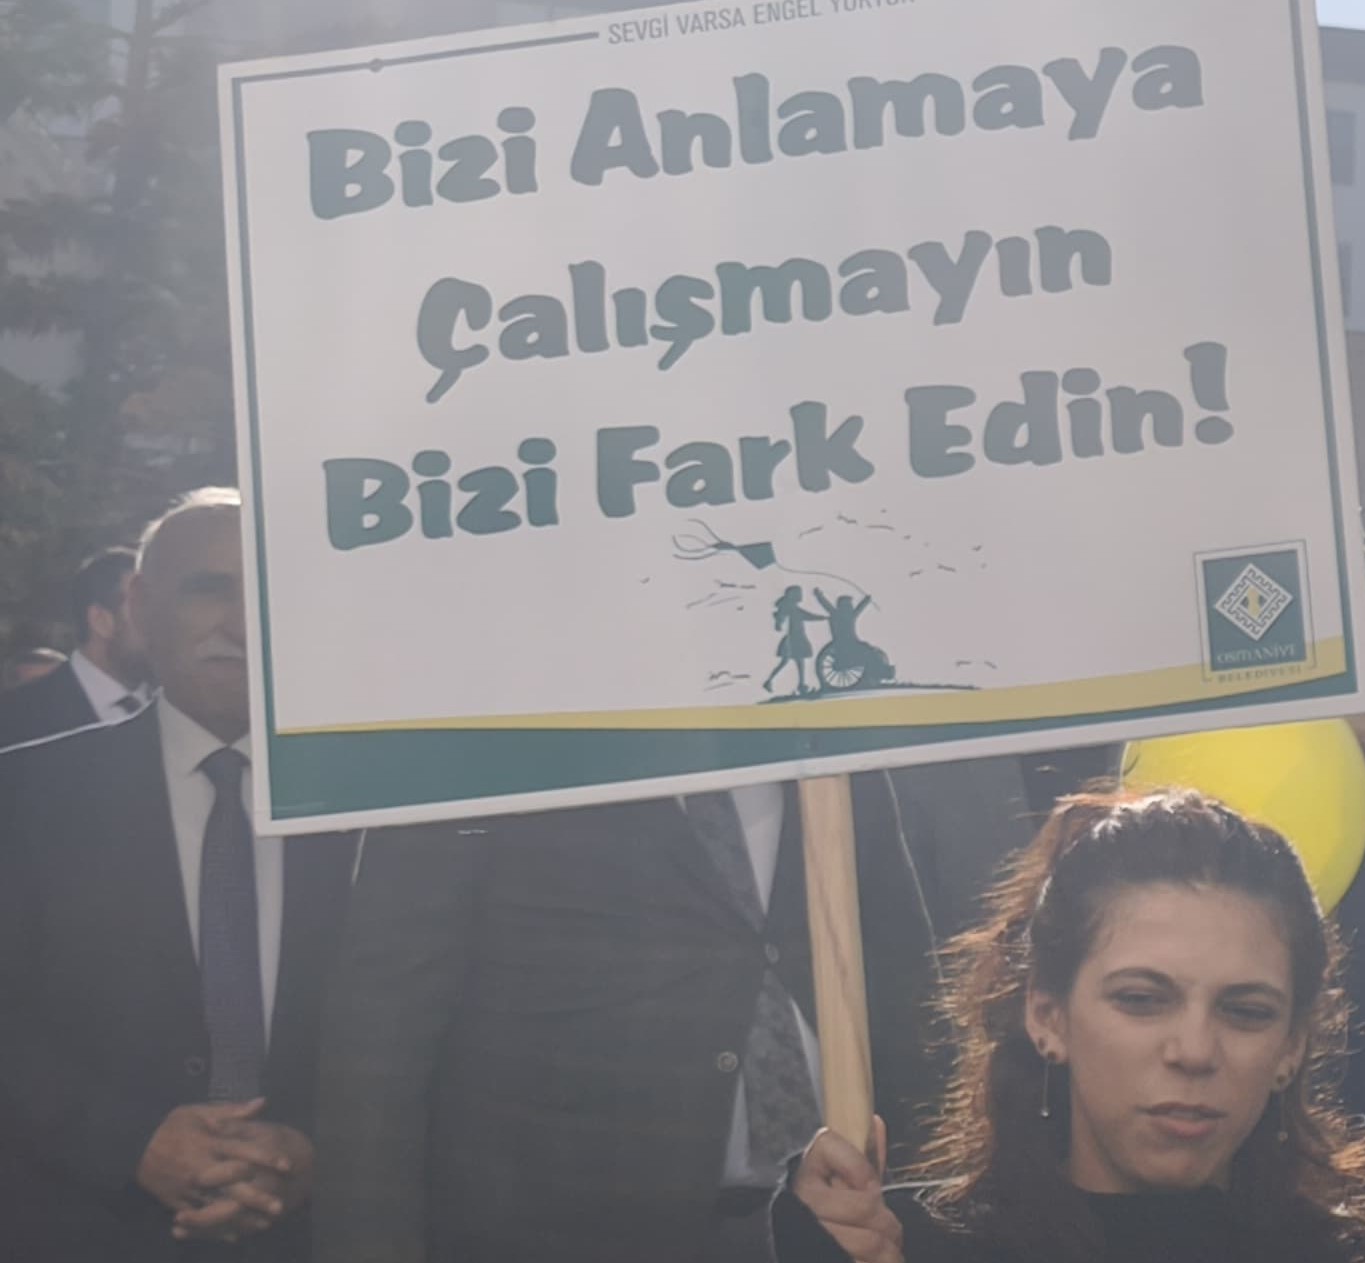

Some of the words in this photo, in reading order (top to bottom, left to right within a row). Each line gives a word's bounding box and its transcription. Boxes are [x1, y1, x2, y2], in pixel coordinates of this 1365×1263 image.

[608, 13, 668, 44] SEVGİ
[676, 7, 746, 35] VARSA
[753, 0, 823, 25] ENGEL
[307, 107, 537, 221] Bizi
[571, 46, 1204, 186] Anlamaya
[417, 226, 1112, 404] Çalışmayın
[322, 438, 560, 552] Bizi
[596, 401, 876, 519] Fark
[904, 341, 1235, 478] Edin!
